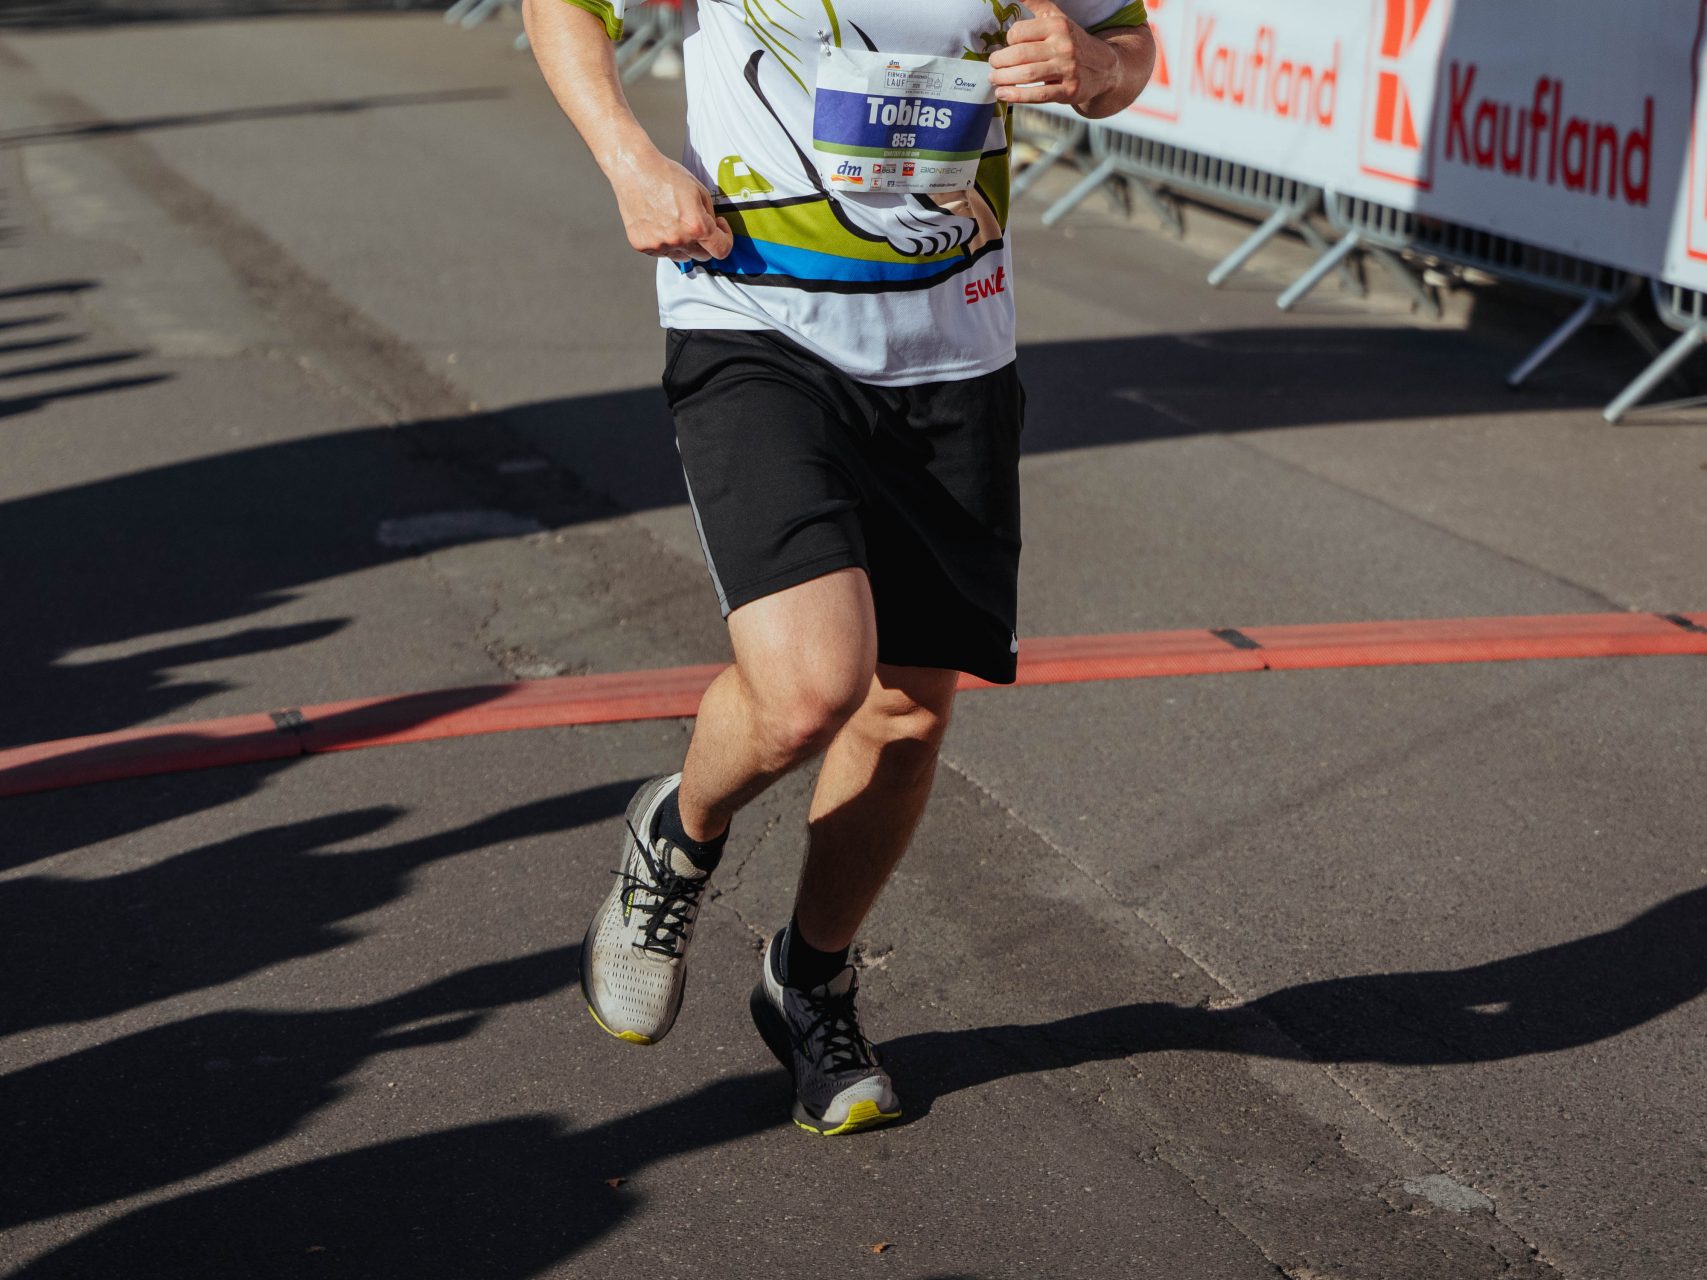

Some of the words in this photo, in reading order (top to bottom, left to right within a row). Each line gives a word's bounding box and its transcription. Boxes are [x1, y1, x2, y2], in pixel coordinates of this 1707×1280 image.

[886, 78, 905, 87] LAUF
[1190, 14, 1341, 128] Kaufland
[867, 96, 952, 129] Tobias
[891, 132, 916, 148] 855
[1445, 59, 1655, 207] Kaufland
[836, 160, 862, 176] dm
